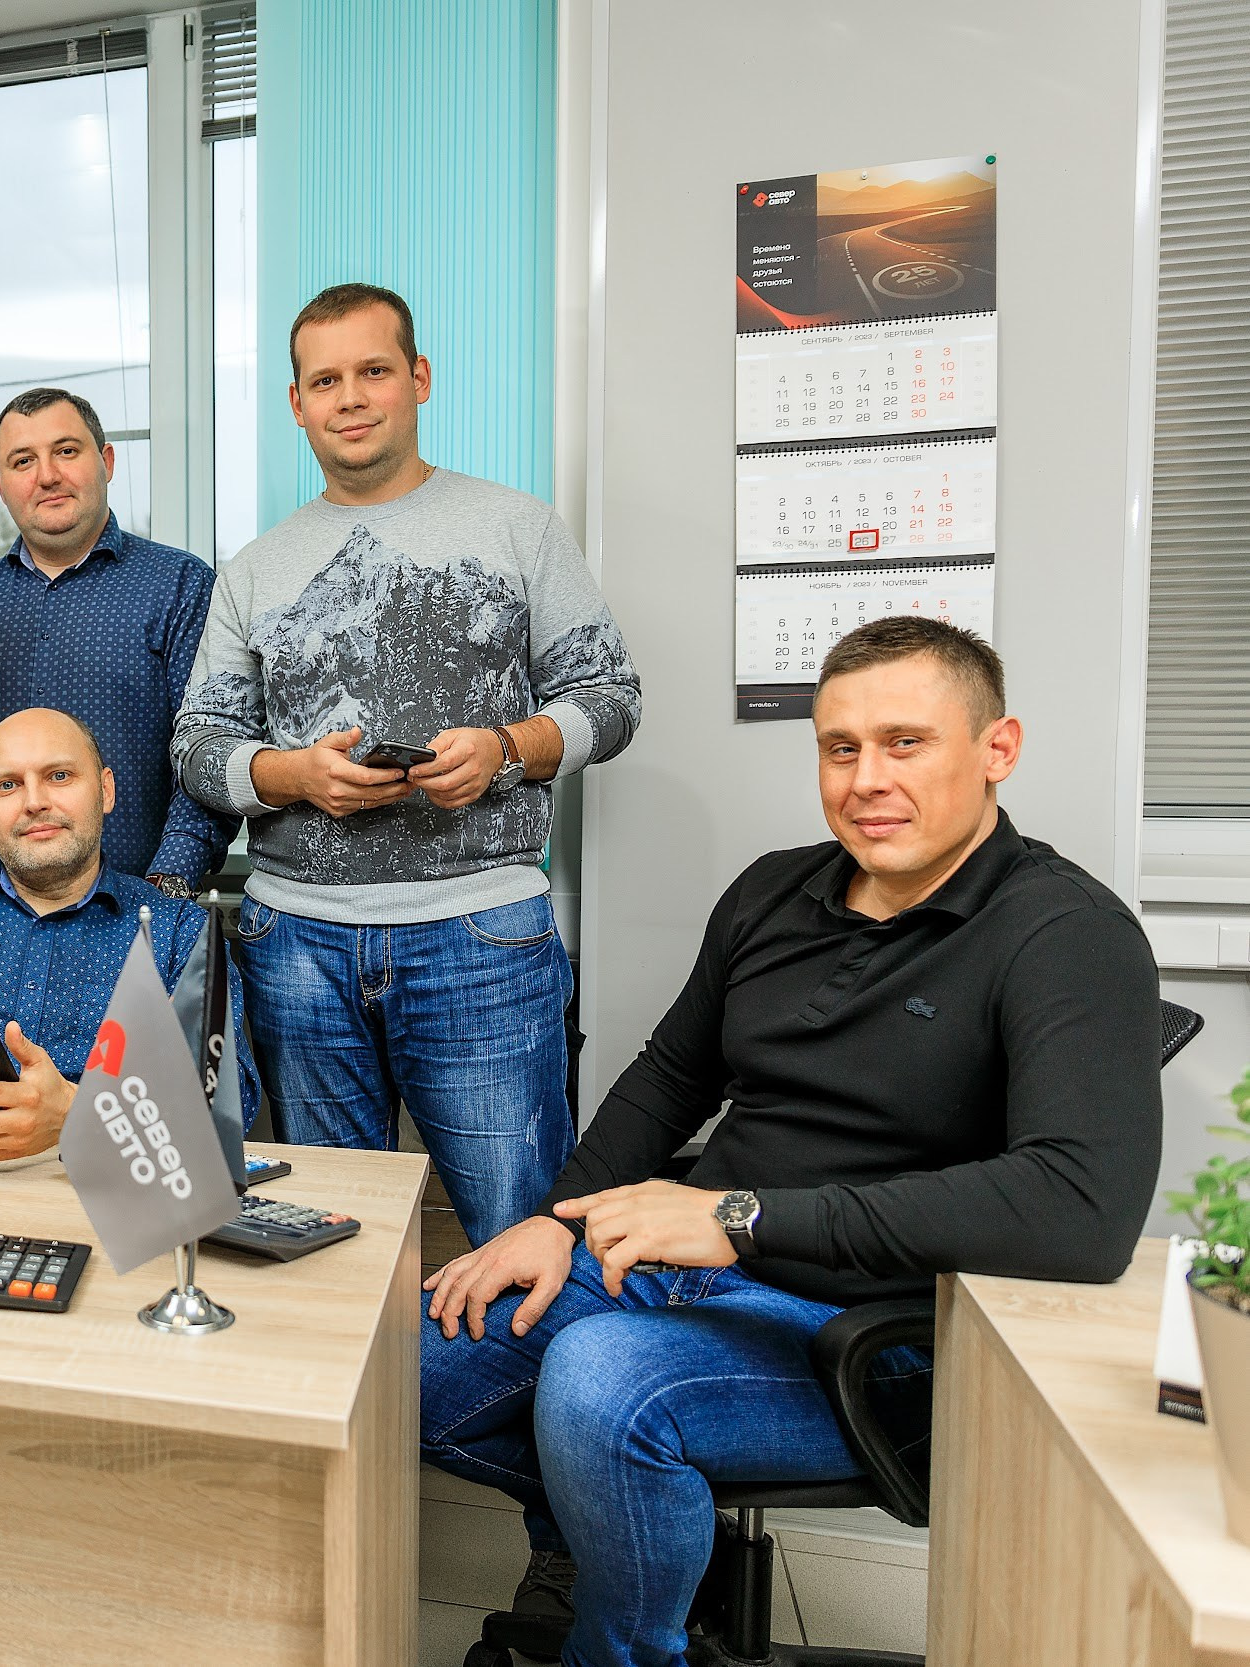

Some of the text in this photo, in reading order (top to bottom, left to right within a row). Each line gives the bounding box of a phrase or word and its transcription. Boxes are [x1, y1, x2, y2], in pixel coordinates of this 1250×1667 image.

[768, 189, 796, 199] север
[768, 197, 790, 206] авто
[752, 244, 791, 255] Времена
[752, 255, 795, 265] меняются
[752, 268, 783, 278] друзья
[891, 265, 937, 284] 25
[752, 278, 793, 288] остаются
[914, 276, 942, 289] ЛЕТ
[801, 337, 843, 345] СЕНТЯБРЬ
[884, 328, 934, 338] SEPTEMBER
[914, 349, 922, 359] 2
[943, 346, 951, 356] 3
[778, 361, 955, 384] 4 5 6 7 8 9 10
[776, 376, 955, 398] 11 12 13 14 15 16 17
[776, 391, 955, 413] 18 19 20 21 22 23 24
[775, 408, 927, 428] 25 26 27 28 29 30
[805, 460, 842, 468] ОКТЯБРЬ
[883, 454, 922, 463] OCTOBER
[779, 497, 786, 507] 2
[805, 496, 812, 506] 3
[831, 495, 839, 503] 4
[858, 493, 866, 503] 5
[885, 491, 894, 501] 6
[913, 489, 921, 499] 7
[941, 488, 950, 498] 8
[779, 502, 953, 521] 9 10 11 12 13 14 15
[777, 526, 790, 535] 16
[802, 525, 816, 534] 17
[829, 524, 842, 533] 18
[882, 520, 898, 530] 20
[909, 519, 923, 529] 21
[937, 517, 953, 527] 22
[827, 539, 842, 547] 25
[854, 537, 869, 546] 26
[882, 536, 897, 545] 27
[909, 534, 925, 544] 28
[937, 532, 953, 542] 29
[809, 582, 842, 590] НОЯБРЬ
[882, 579, 928, 587] NOVEMBER
[858, 601, 866, 611] 2
[885, 600, 893, 610] 3
[911, 600, 920, 609] 4
[939, 599, 947, 609] 5
[778, 618, 786, 628] 6
[805, 617, 812, 627] 7
[831, 617, 839, 626] 8
[776, 631, 842, 642] 13 14 15
[775, 647, 790, 656] 20
[801, 646, 814, 656] 21
[775, 661, 789, 671] 27
[801, 661, 816, 670] 28
[94, 1091, 156, 1185] авто
[121, 1076, 192, 1200] север
